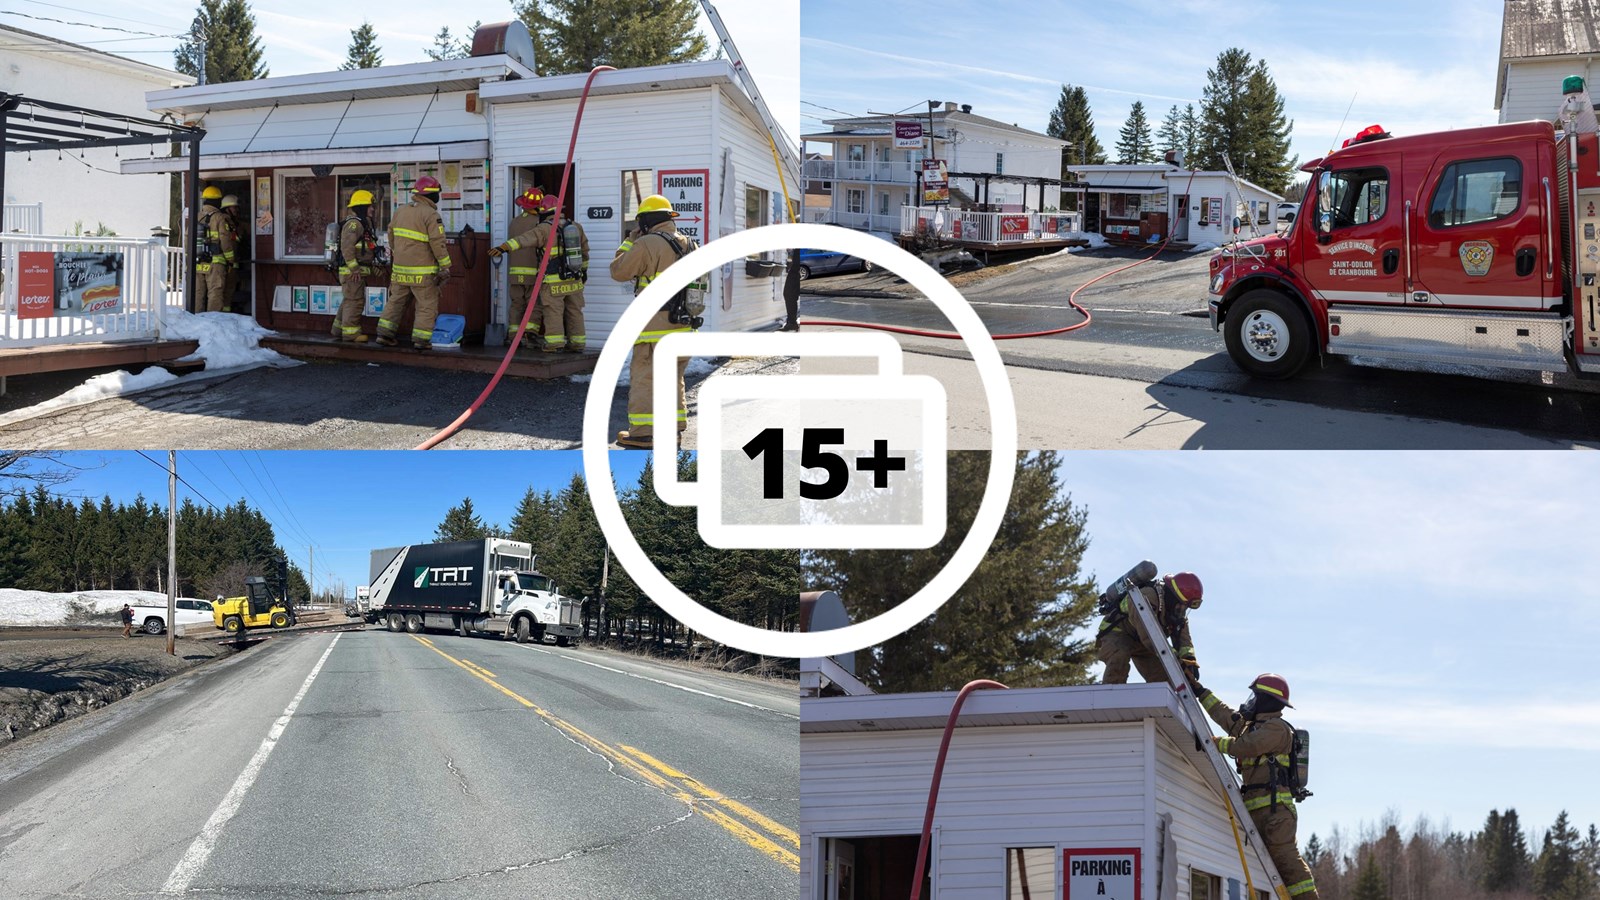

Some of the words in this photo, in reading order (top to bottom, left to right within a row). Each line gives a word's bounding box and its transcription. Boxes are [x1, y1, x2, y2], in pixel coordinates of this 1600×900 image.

[664, 176, 702, 188] PARKING
[680, 189, 685, 199] À
[593, 209, 608, 217] 317
[1328, 242, 1348, 255] SERVICE
[1349, 242, 1376, 255] D'INCENDIE
[416, 276, 423, 284] 17
[1072, 860, 1131, 876] PARKING
[1097, 879, 1106, 895] À
